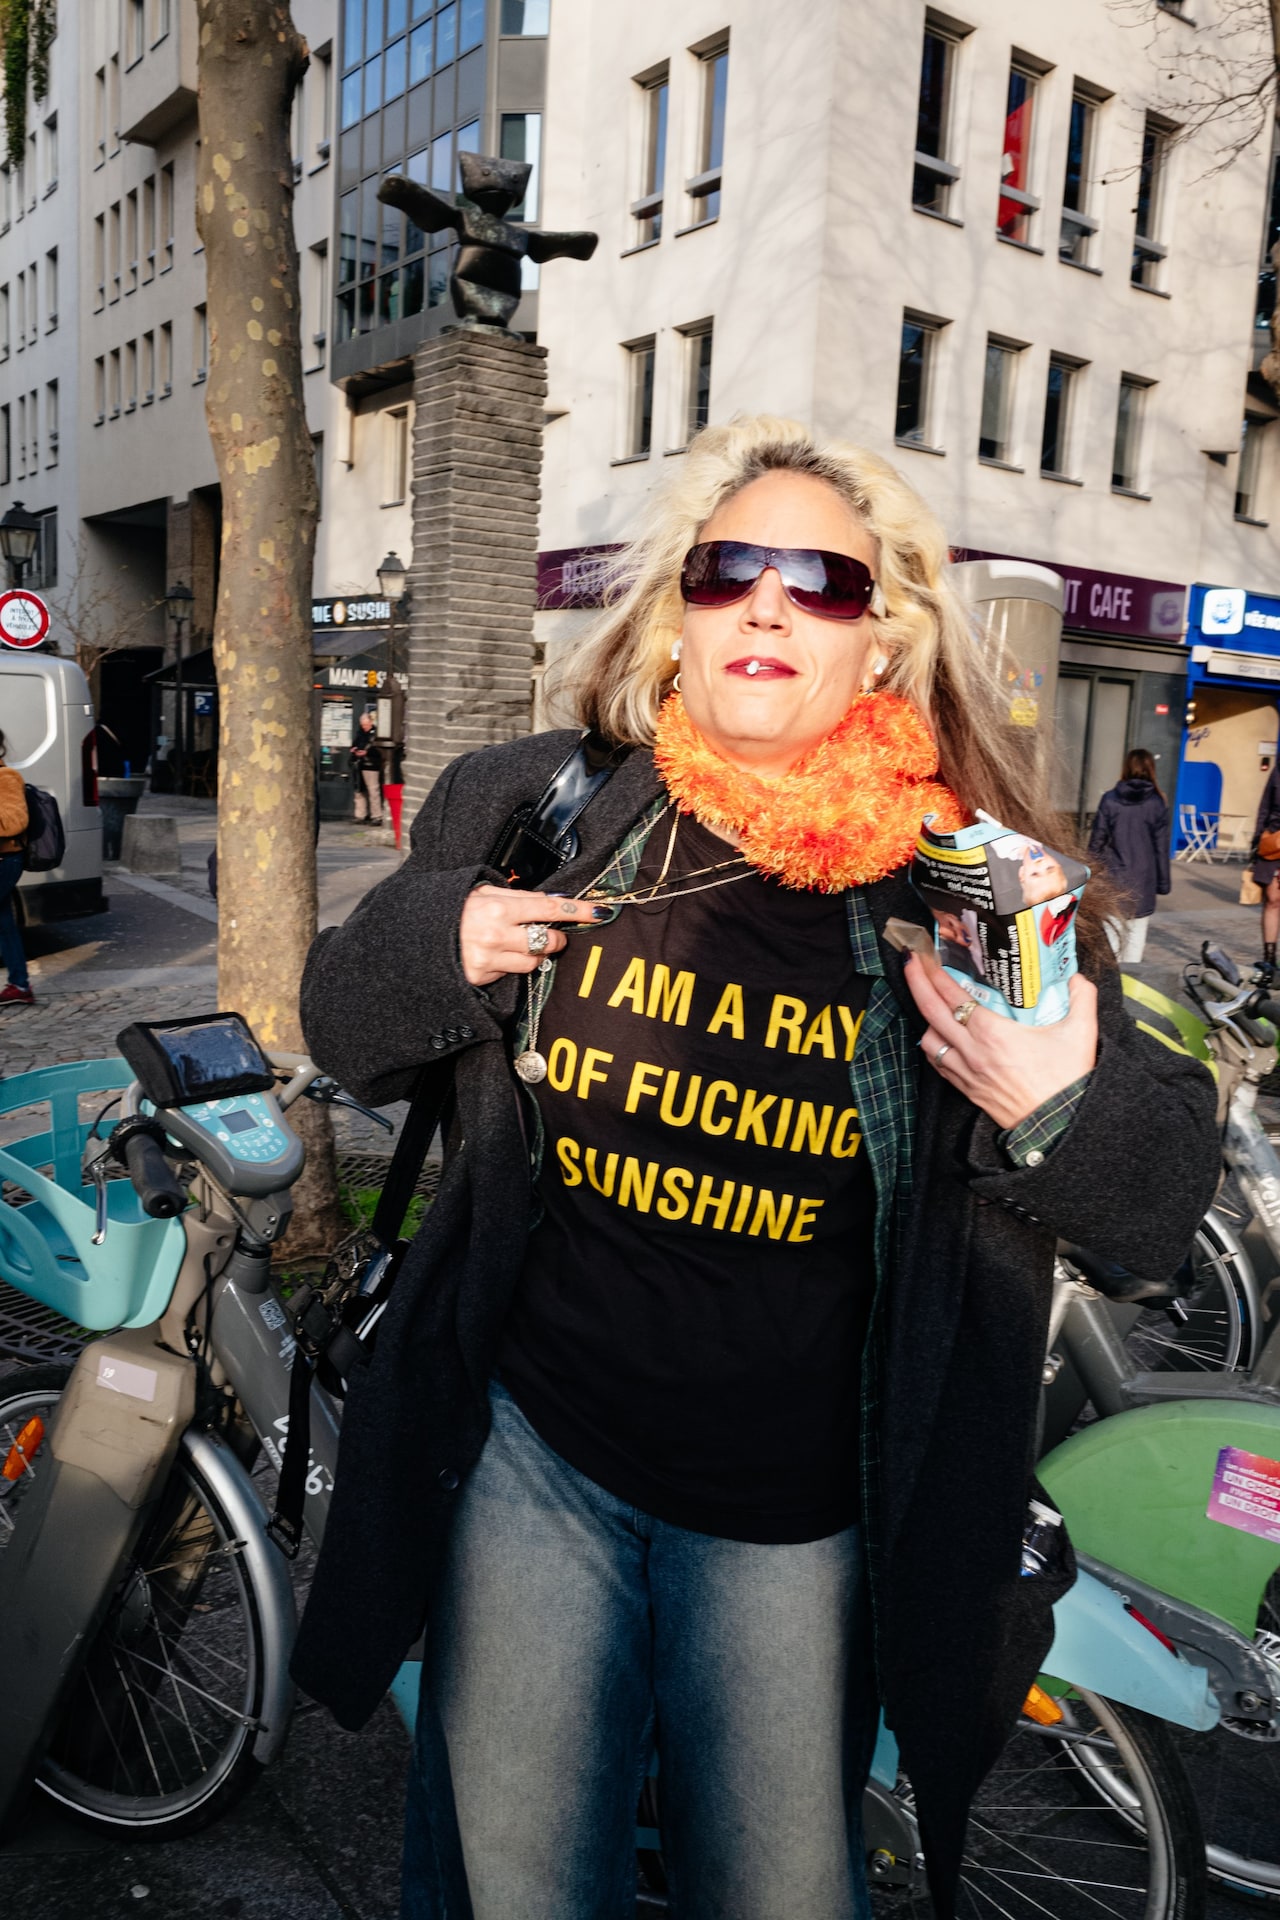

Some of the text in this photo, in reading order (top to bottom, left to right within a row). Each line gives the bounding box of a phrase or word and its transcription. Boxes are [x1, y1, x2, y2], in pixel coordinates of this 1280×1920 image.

[1090, 583, 1133, 621] CAFE
[329, 667, 369, 688] MAMIE
[578, 945, 866, 1062] I AM A RAY
[1010, 964, 1024, 1007] cominciare
[547, 1037, 863, 1158] OF FUCKING
[556, 1136, 825, 1243] SUNSHINE
